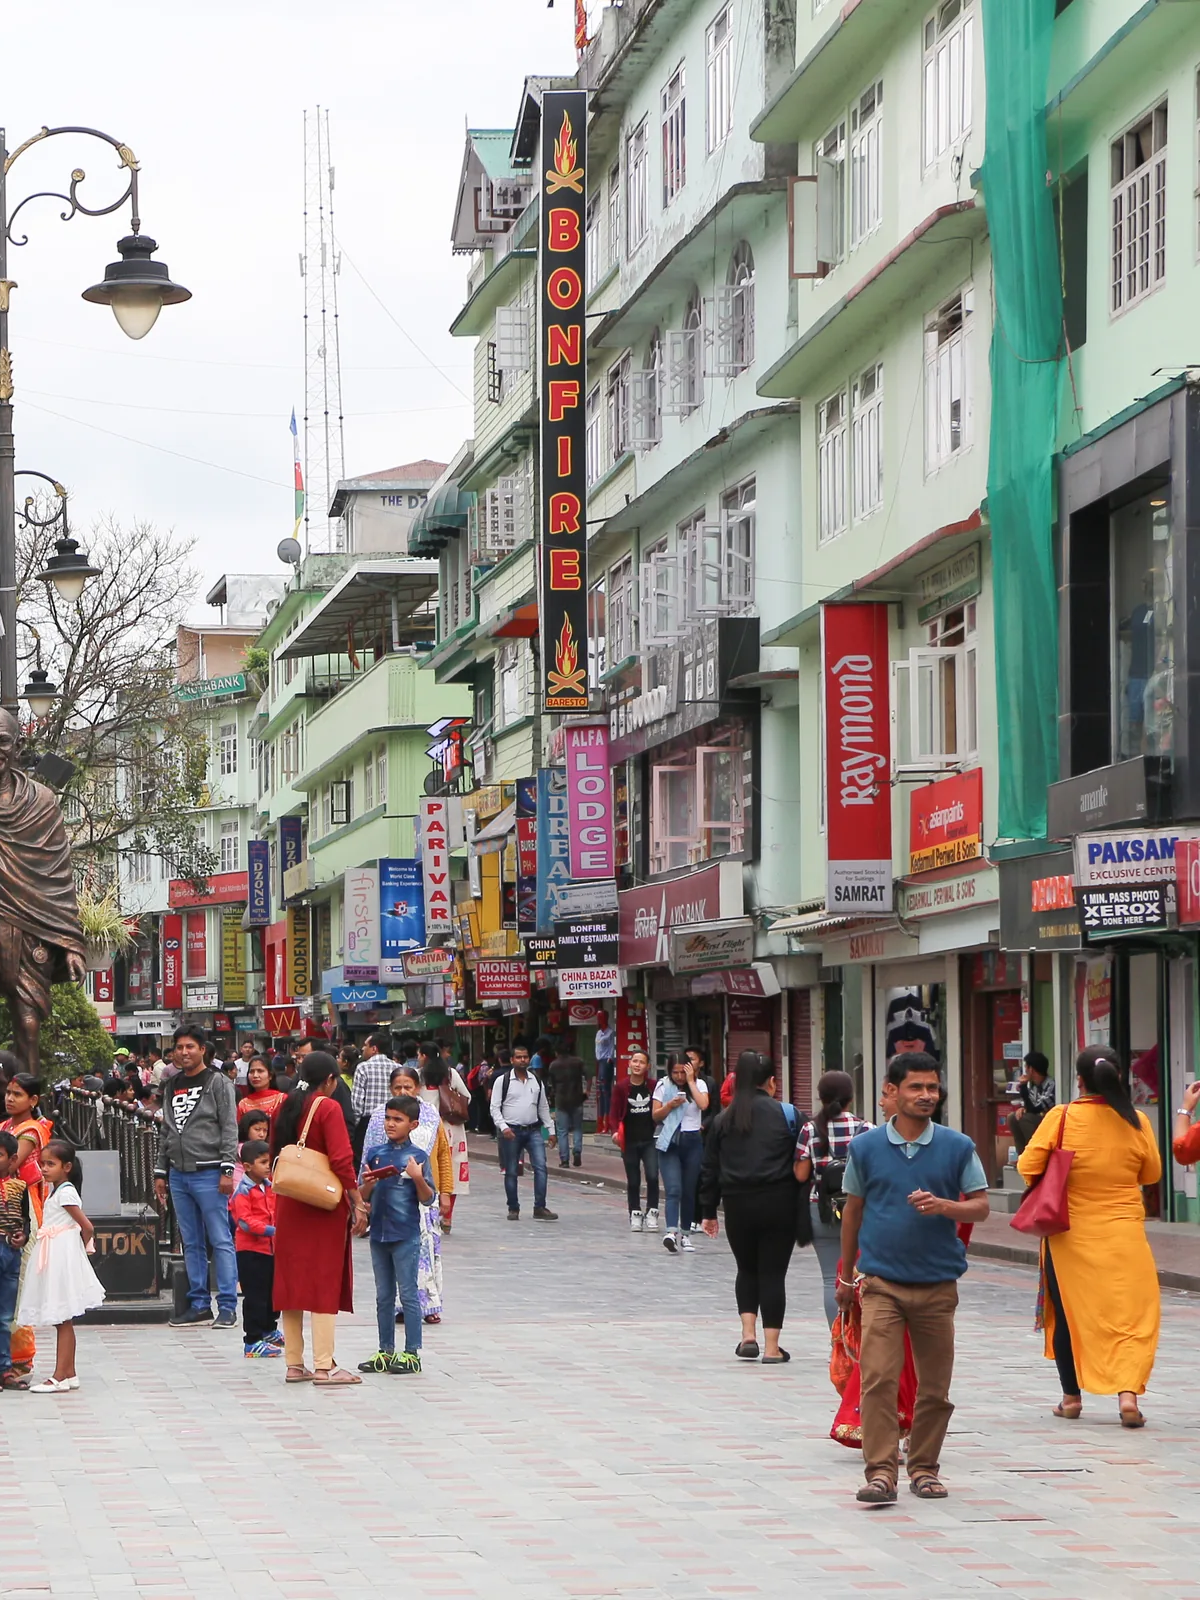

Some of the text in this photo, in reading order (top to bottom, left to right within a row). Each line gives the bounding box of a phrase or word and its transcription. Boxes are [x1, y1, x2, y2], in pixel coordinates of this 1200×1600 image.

[547, 207, 582, 591] BONFIRE
[380, 495, 402, 506] THE
[547, 696, 587, 706] BARESTO
[572, 730, 604, 747] ALFA
[830, 654, 886, 808] Raymond
[1079, 785, 1109, 812] amante
[575, 752, 608, 870] LODGE
[285, 841, 297, 869] DZO
[962, 840, 976, 859] Sons
[1087, 837, 1179, 865] PAKSAM
[427, 803, 449, 920] PARIVAR
[1090, 865, 1176, 880] EXCLUSIVE CENTR
[253, 863, 265, 906] DZONG
[961, 879, 976, 898] SONS
[834, 885, 886, 902] SAMRAT
[1089, 892, 1108, 905] MIN.
[1109, 891, 1131, 903] PASS
[1131, 889, 1160, 902] PHOTO
[349, 873, 374, 963] firstcry
[686, 898, 707, 922] BANK
[1084, 903, 1161, 918] XEROX
[1102, 915, 1144, 925] DONE HERE
[570, 924, 607, 933] BONFIRE
[529, 940, 555, 950] CHINA
[558, 934, 619, 944] FAMILY RESTAURANT
[721, 938, 746, 949] Flight
[850, 933, 885, 959] SAMRAT
[294, 907, 307, 996] GOLDEN TIPS
[410, 952, 447, 965] PARIVAR
[536, 951, 555, 961] GIFT
[584, 953, 597, 962] BAR
[166, 955, 175, 987] kotak
[479, 962, 528, 973] MONEY
[561, 969, 617, 981] CHINA BAZAR
[569, 981, 612, 990] GIFTSHOP
[341, 988, 377, 1000] vivo
[629, 1105, 649, 1114] adidas
